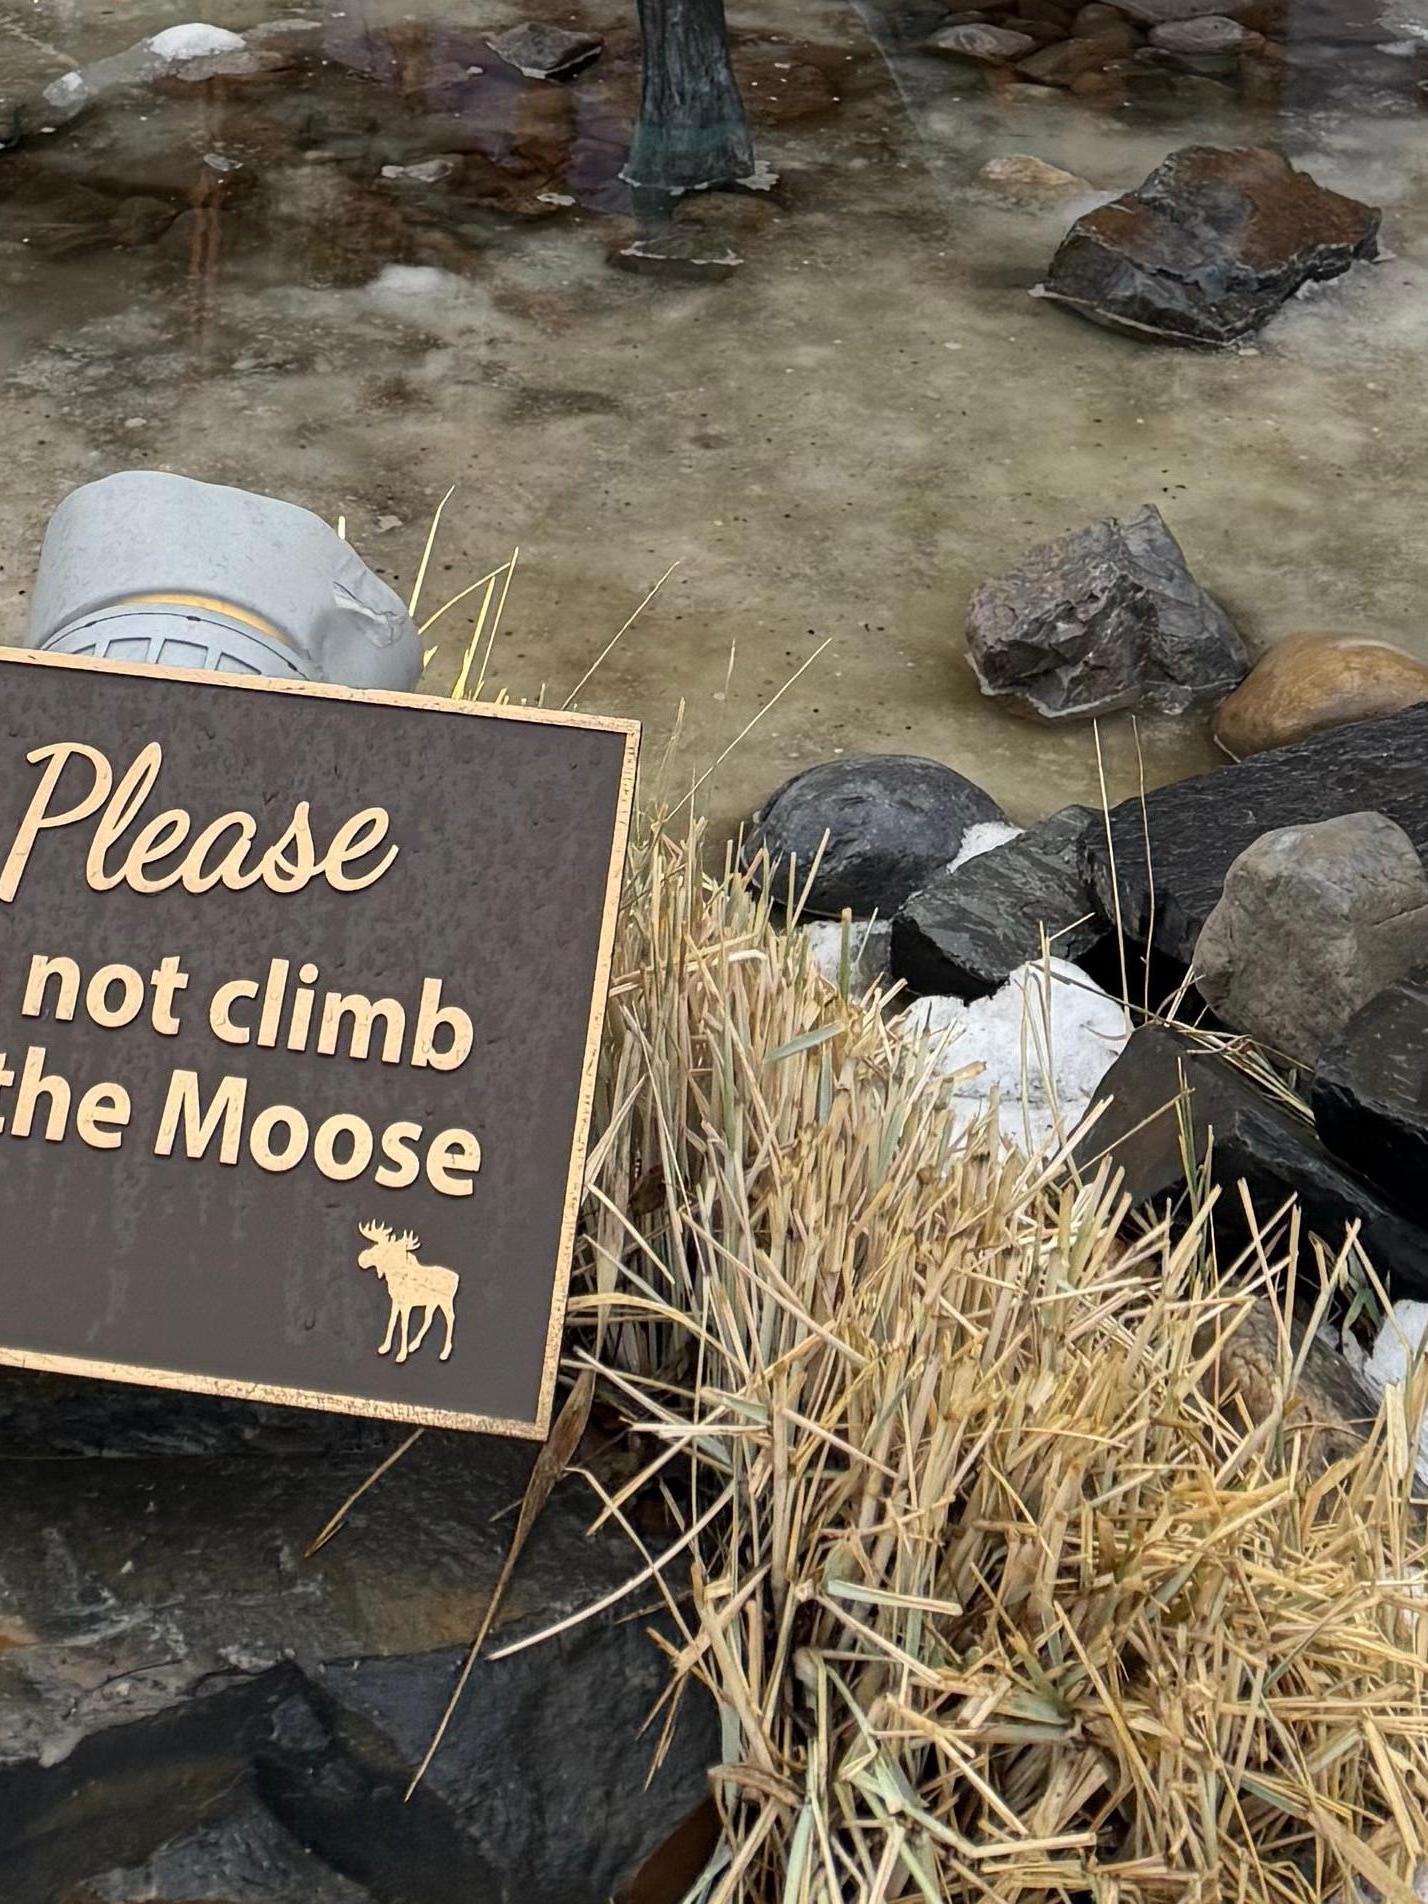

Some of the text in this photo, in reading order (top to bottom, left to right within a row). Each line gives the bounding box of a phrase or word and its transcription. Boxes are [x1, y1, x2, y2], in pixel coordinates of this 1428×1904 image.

[20, 955, 189, 1036] not
[208, 958, 474, 1072] climb
[153, 1070, 482, 1197] Moose
